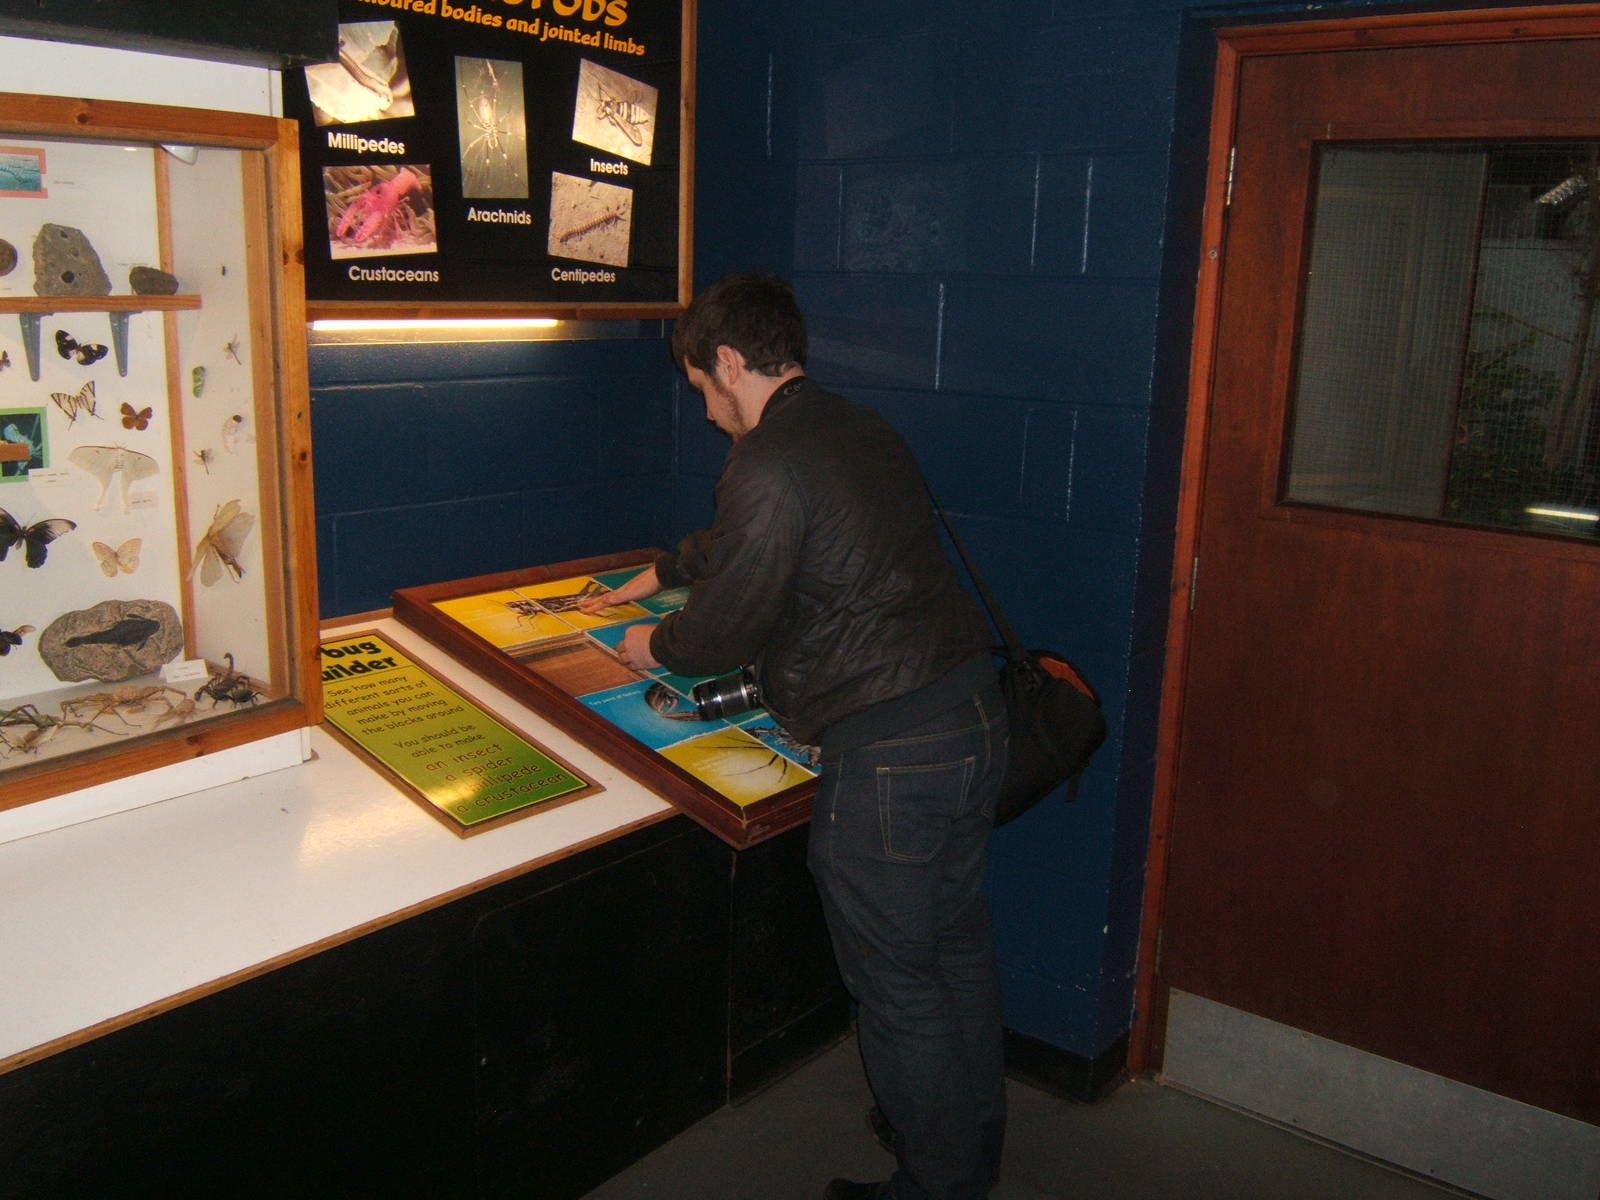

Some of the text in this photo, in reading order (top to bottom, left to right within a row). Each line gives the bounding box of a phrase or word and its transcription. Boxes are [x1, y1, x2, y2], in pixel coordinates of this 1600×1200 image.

[361, 0, 645, 56] oured bodies and jointed limbs
[328, 132, 405, 155] Millipedes
[590, 158, 628, 175] Insects
[467, 207, 532, 225] Arachnids
[349, 265, 440, 283] Crustaceans
[551, 268, 616, 283] Centipedes
[320, 641, 382, 658] bug
[322, 656, 397, 682] uilder
[325, 680, 428, 709] different sorts of
[327, 676, 408, 697] See how many
[347, 691, 434, 716] animals you can
[358, 699, 449, 726] make by moving
[361, 705, 465, 736] the blocks around
[393, 723, 476, 750] You should be
[411, 733, 486, 759] able to make
[425, 742, 504, 772] an insect
[445, 755, 514, 782] a spider
[468, 763, 542, 793] millipede
[456, 803, 469, 814] a
[474, 772, 566, 808] crustacean
